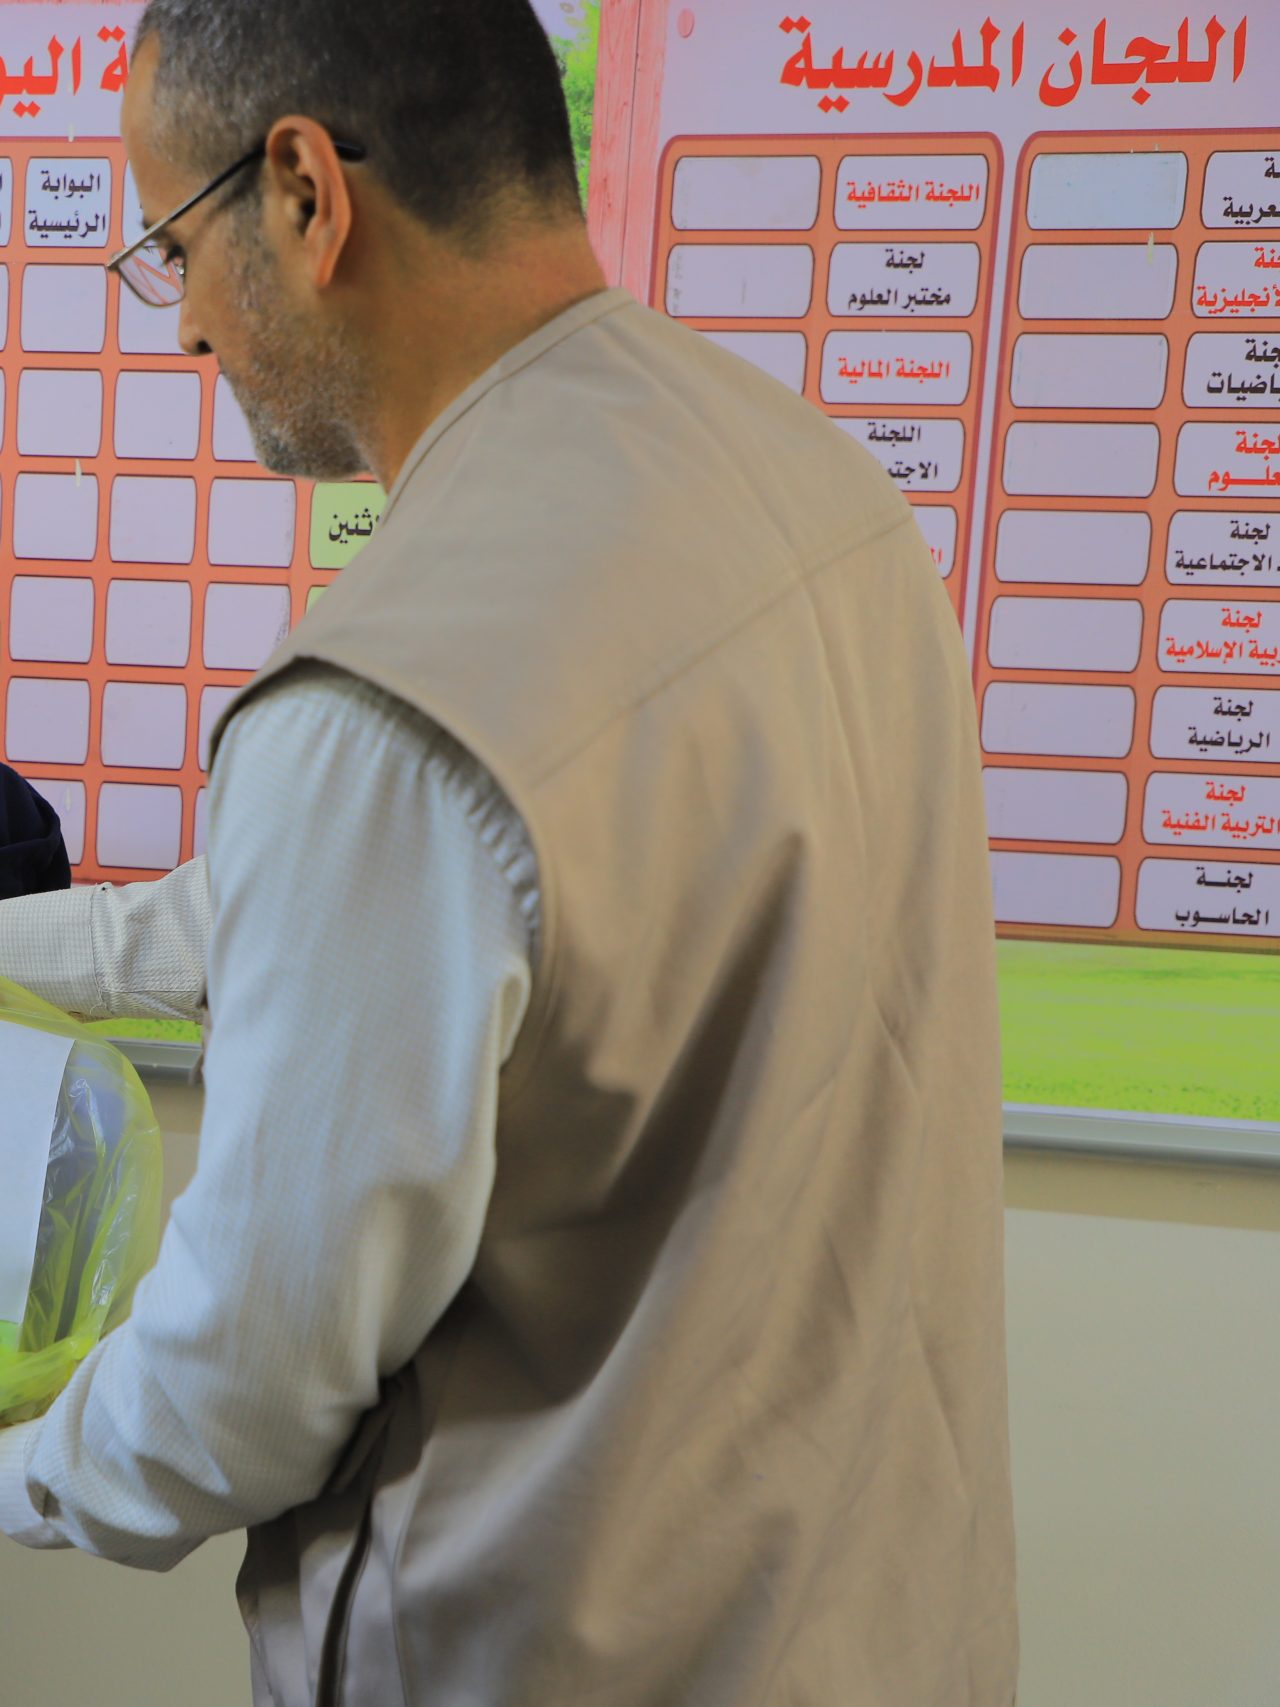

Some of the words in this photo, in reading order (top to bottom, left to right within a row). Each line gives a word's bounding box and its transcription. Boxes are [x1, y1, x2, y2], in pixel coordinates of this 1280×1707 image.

[779, 16, 1024, 112] المدرسية
[1039, 16, 1247, 107] اللجان
[41, 171, 100, 199] البوابة
[848, 180, 919, 208] الثقافية
[926, 181, 979, 206] اللجنة
[28, 209, 105, 239] الرئيسية
[886, 249, 925, 274] لجنة
[849, 289, 897, 310] العلوم
[902, 288, 950, 312] مختبر
[839, 358, 890, 384] المالية
[896, 358, 950, 383] اللجنة
[867, 422, 921, 447] اللجنة
[1230, 521, 1270, 545] لجنة
[1176, 551, 1271, 576] الاجتماعية
[1222, 608, 1262, 633] لجنة
[1167, 638, 1243, 663] الإسلامية
[1214, 697, 1253, 721] لجنة
[1188, 727, 1269, 754] الرياضية
[1205, 781, 1246, 806] لجنة
[1163, 811, 1216, 835] الفنية
